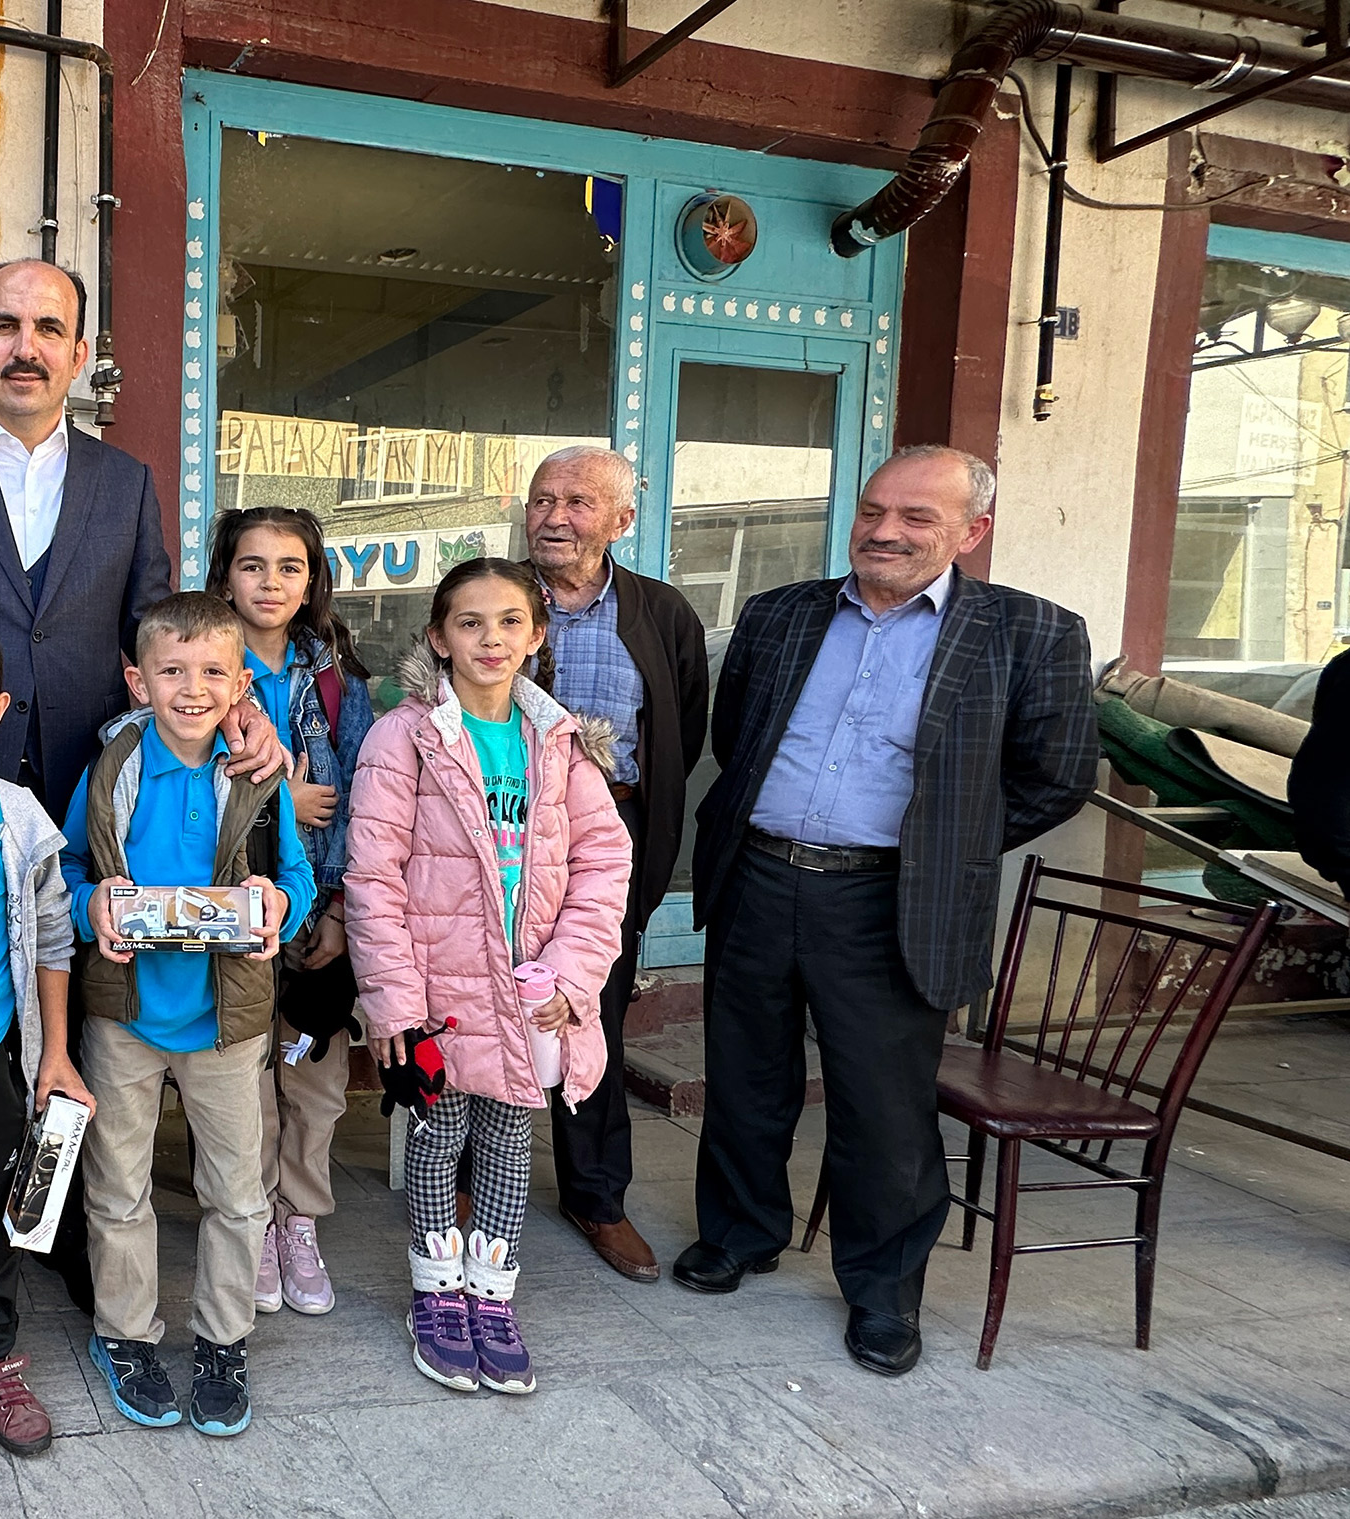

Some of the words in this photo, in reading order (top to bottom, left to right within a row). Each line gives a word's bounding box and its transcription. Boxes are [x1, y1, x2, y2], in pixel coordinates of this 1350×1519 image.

[227, 416, 357, 477] BAHARAT
[113, 942, 132, 950] MAX
[70, 1112, 85, 1140] MAX
[61, 1141, 78, 1173] METAL
